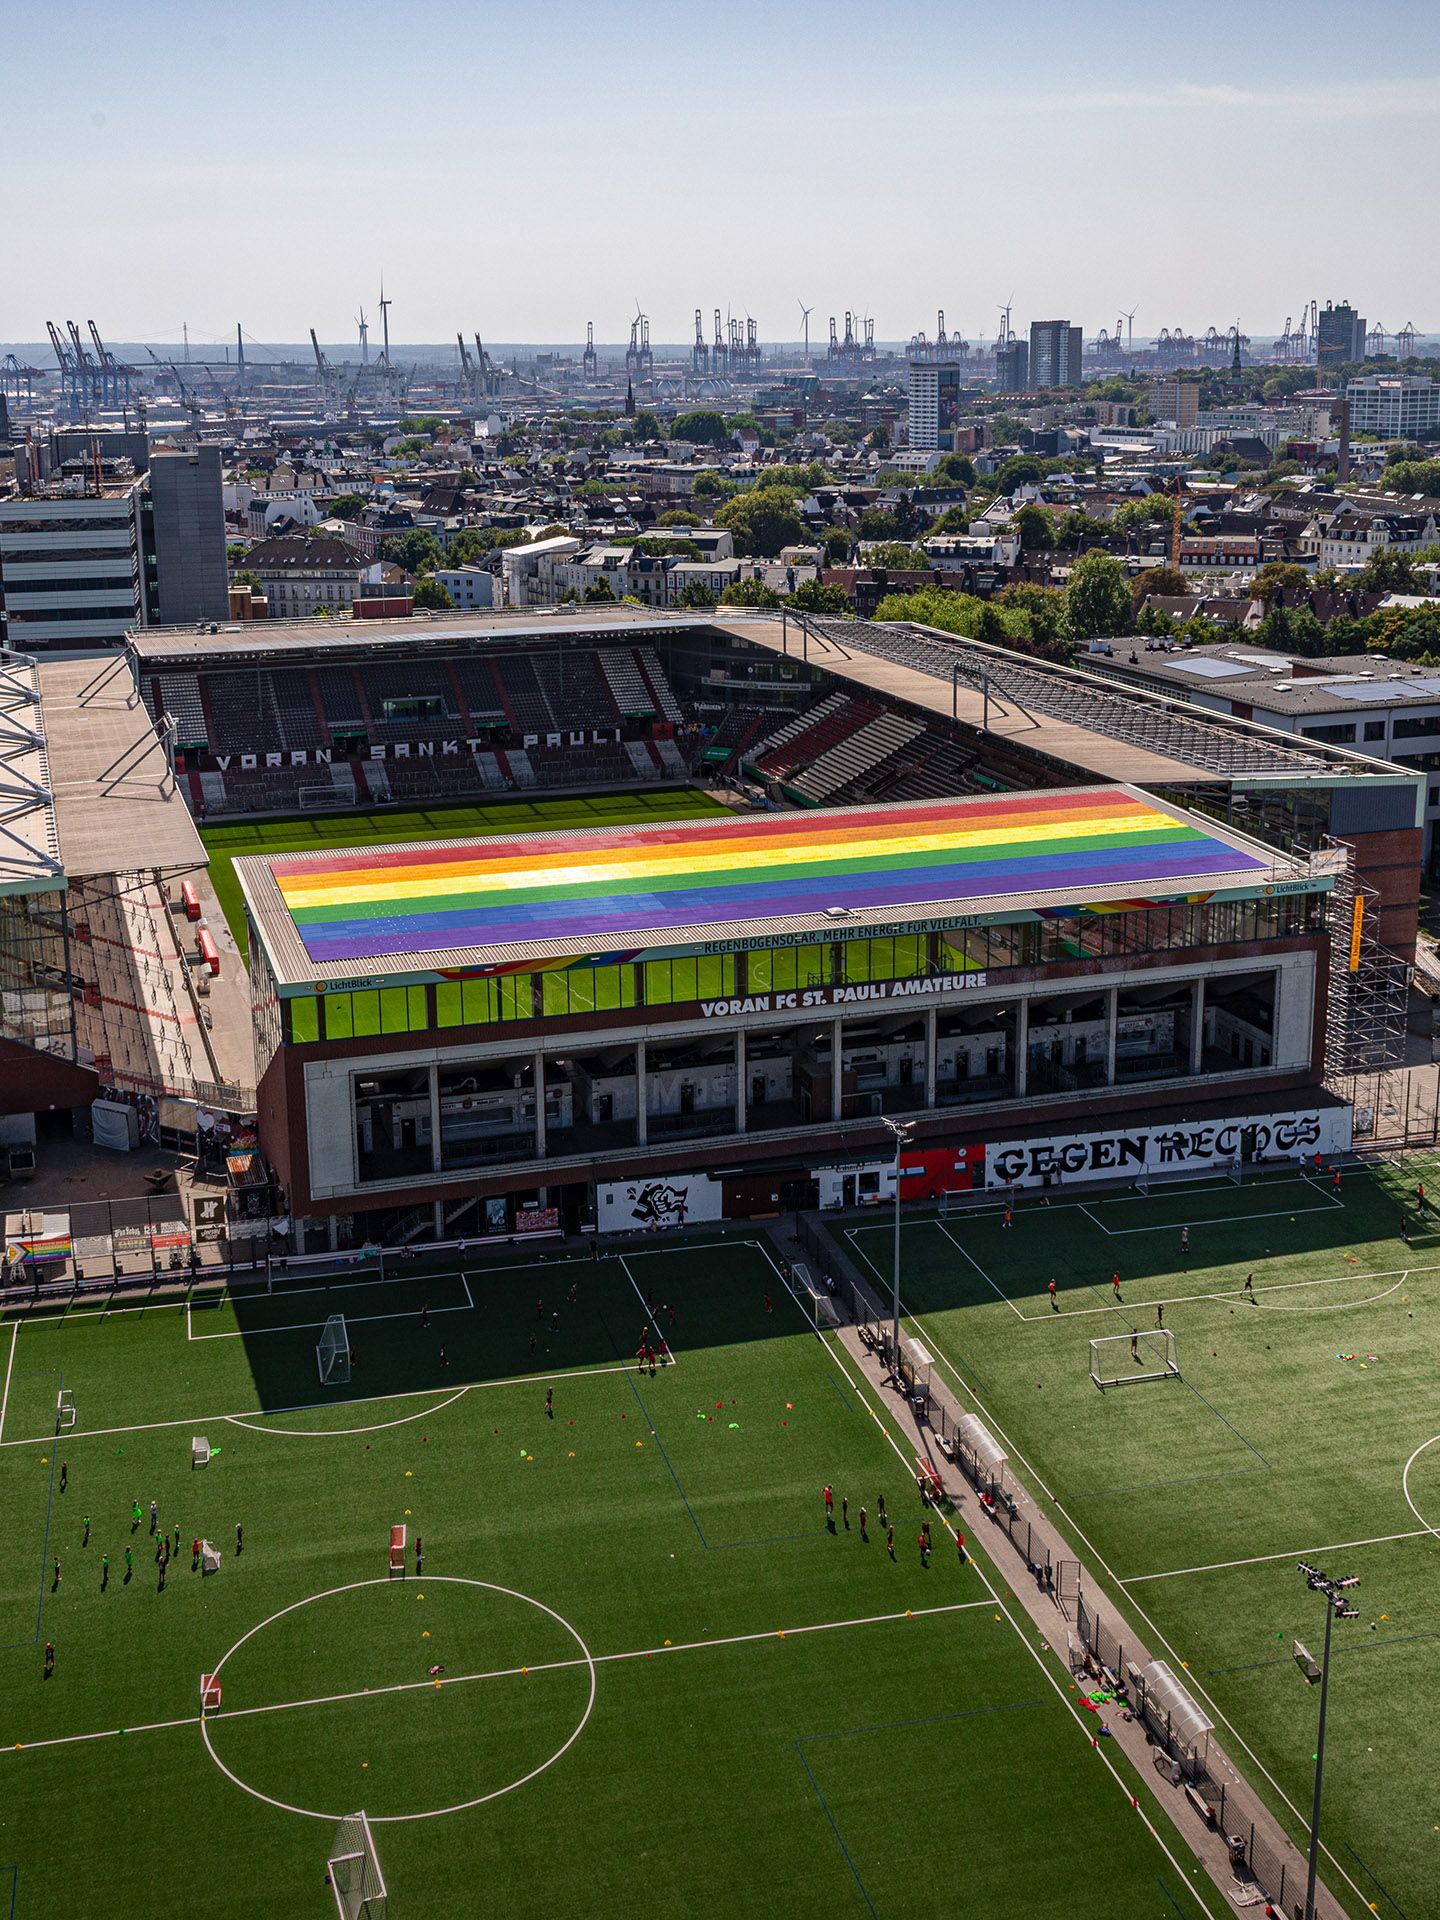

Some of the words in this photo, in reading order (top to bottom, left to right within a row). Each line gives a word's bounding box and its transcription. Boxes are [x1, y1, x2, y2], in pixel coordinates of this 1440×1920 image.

[216, 749, 332, 771] VORAN
[370, 738, 481, 760] SANKT
[523, 729, 621, 749] PAULI
[1276, 882, 1309, 894] LichtBlick
[704, 932, 820, 953] REGENBOGENSOLAR.
[823, 929, 855, 940] MEHR
[859, 923, 904, 938] ENERGIE
[907, 920, 928, 932] FÜR
[931, 915, 982, 930] VIELFALT.
[330, 978, 372, 990] LichtBlick
[701, 996, 769, 1018] VORAN
[775, 993, 797, 1009] FC
[802, 991, 827, 1007] ST.
[833, 983, 886, 1003] PAULI
[891, 973, 987, 997] AMATEURE
[994, 1135, 1149, 1181] GEGEN
